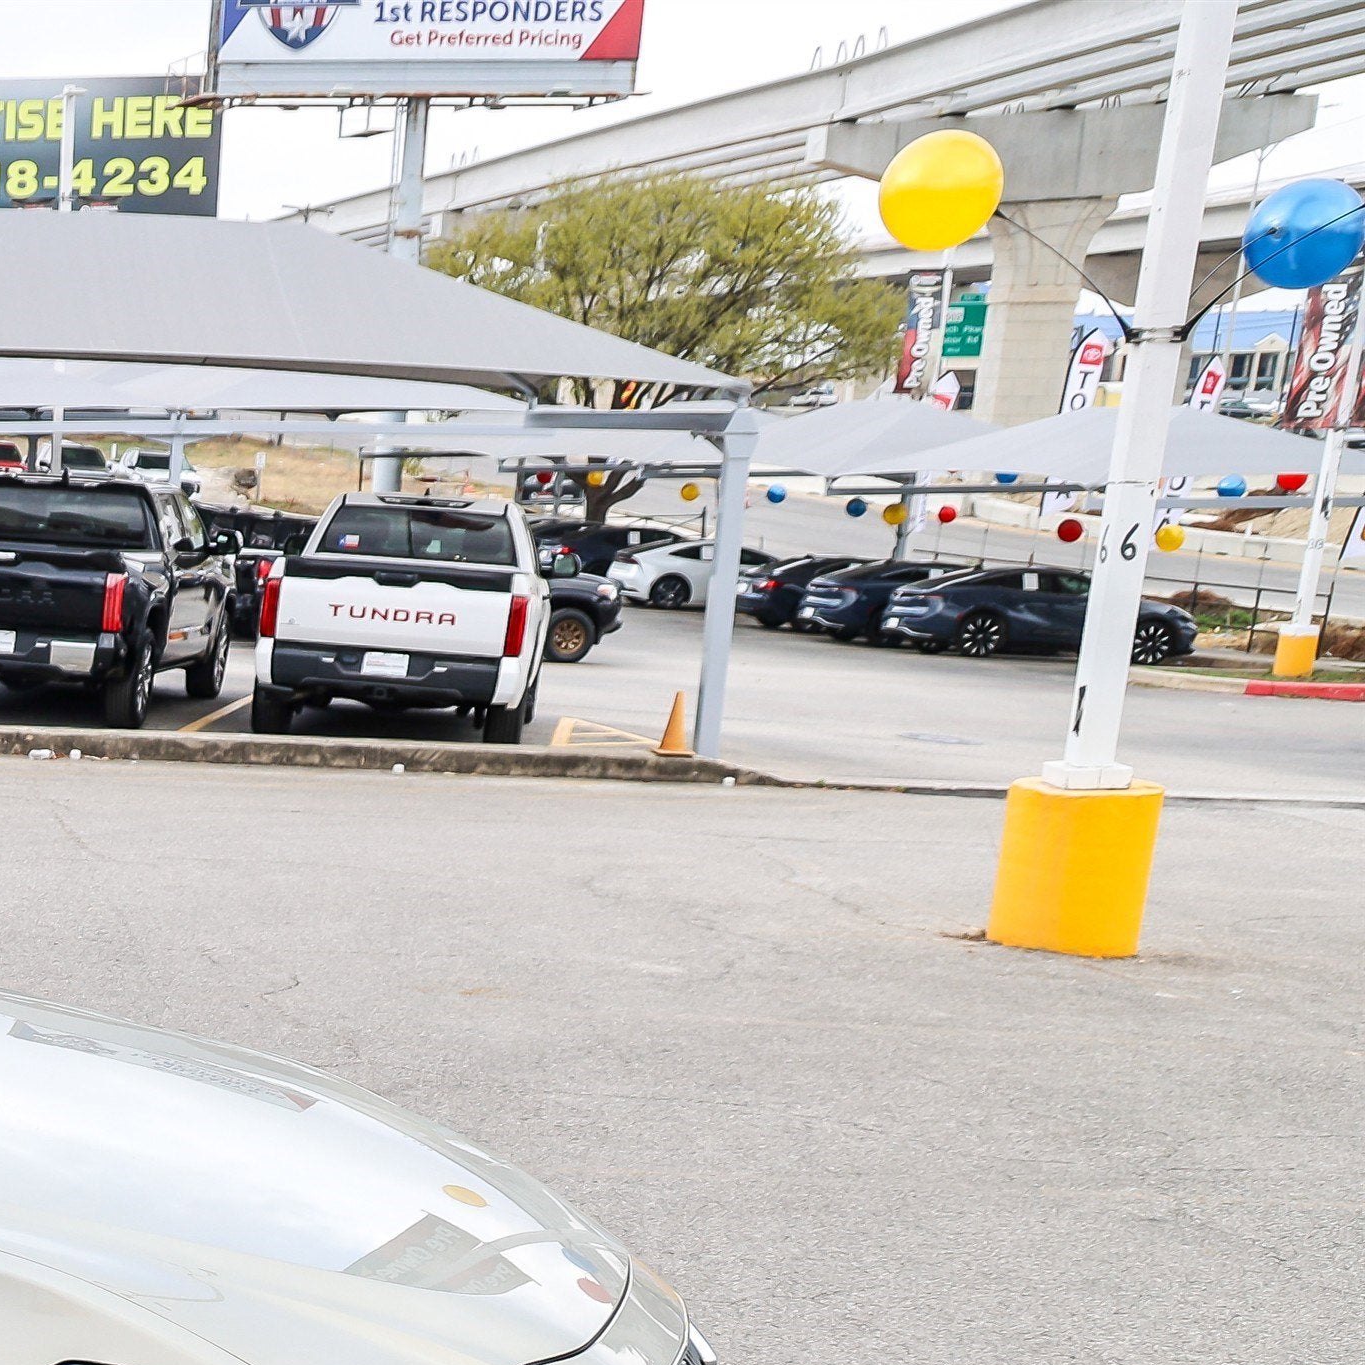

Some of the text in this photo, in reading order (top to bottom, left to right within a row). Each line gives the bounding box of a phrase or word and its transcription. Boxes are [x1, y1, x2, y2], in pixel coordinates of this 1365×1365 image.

[374, 0, 603, 23] 1st RESPONDERS
[390, 28, 583, 50] Get Preferred Pricing
[90, 95, 213, 140] HERE
[902, 297, 935, 388] Pre Owned
[1297, 283, 1349, 419] Pre Owned
[1121, 522, 1141, 562] 6
[328, 603, 457, 626] TUNDRA
